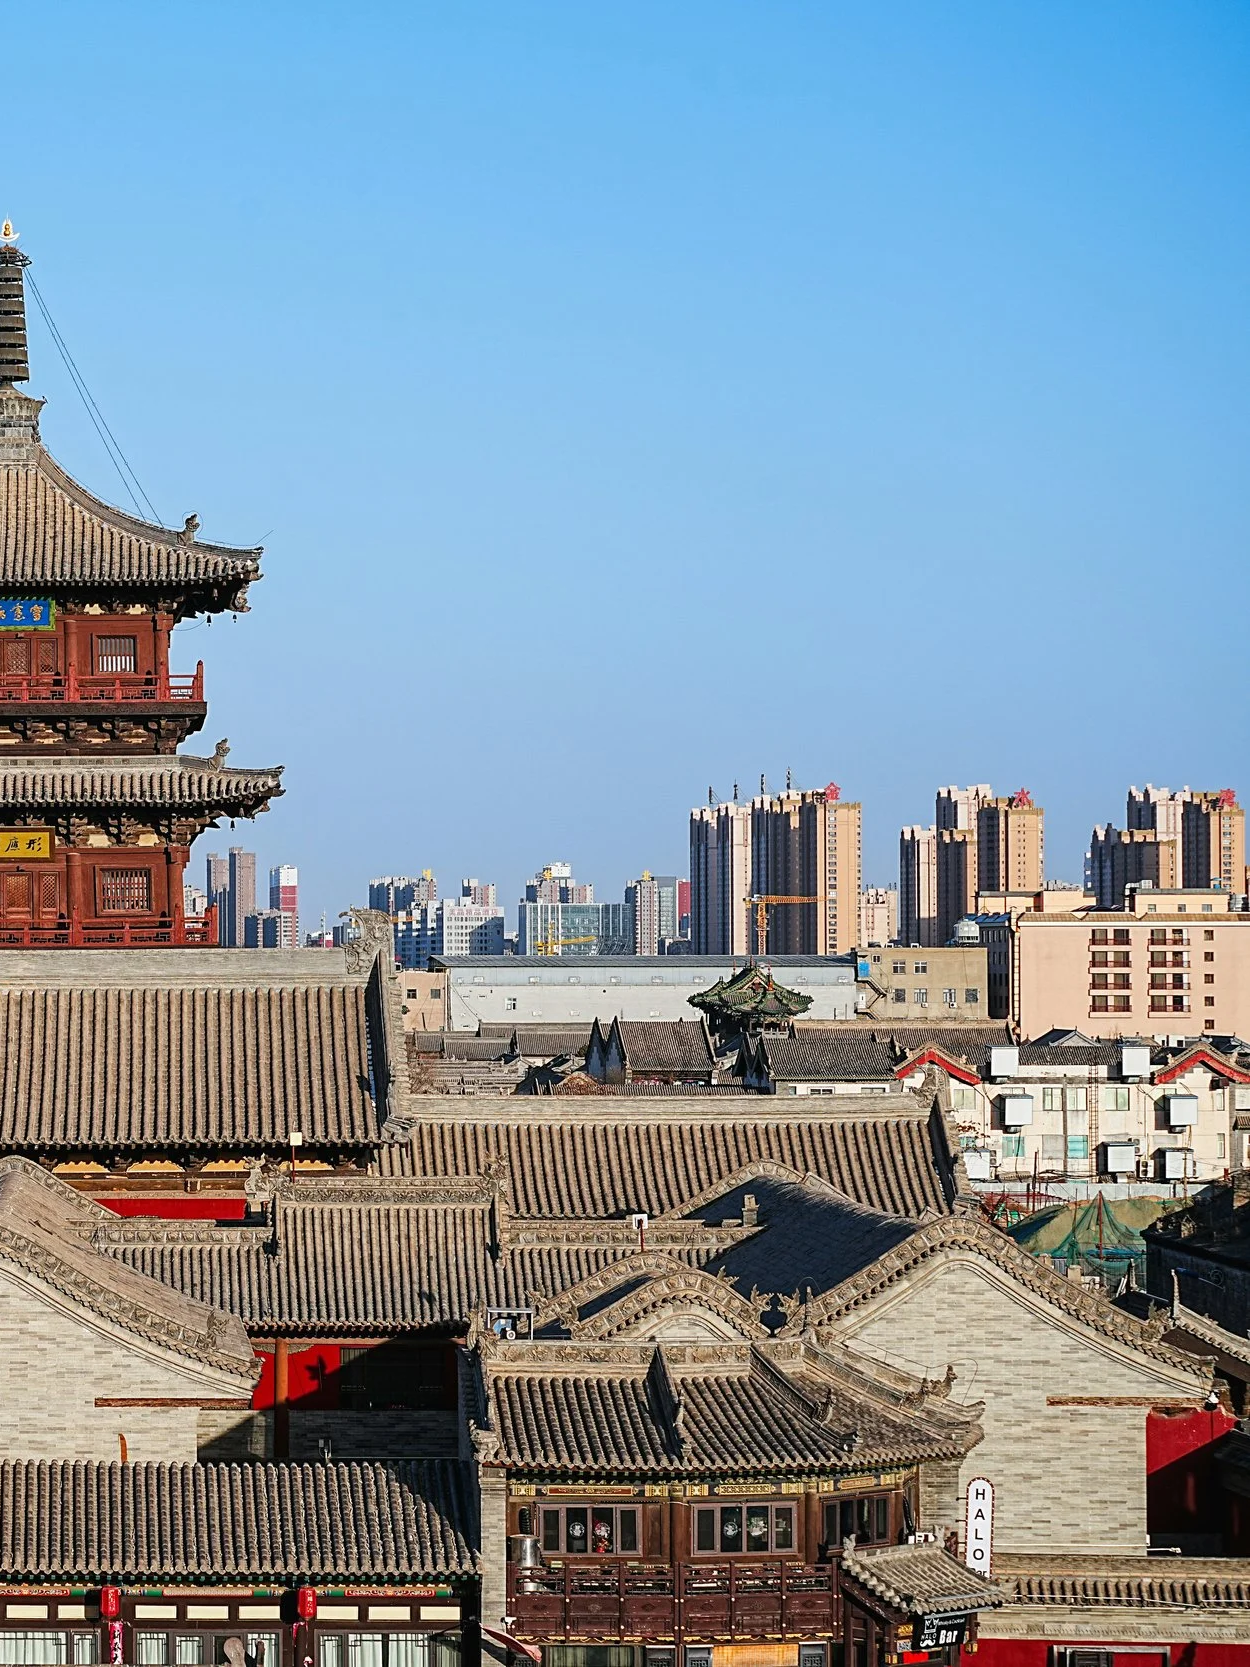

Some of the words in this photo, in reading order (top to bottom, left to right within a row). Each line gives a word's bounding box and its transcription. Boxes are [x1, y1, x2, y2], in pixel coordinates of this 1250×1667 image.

[824, 781, 841, 801] 金
[1013, 787, 1032, 807] 水
[973, 1488, 985, 1560] HALO
[939, 1629, 959, 1645] Bar
